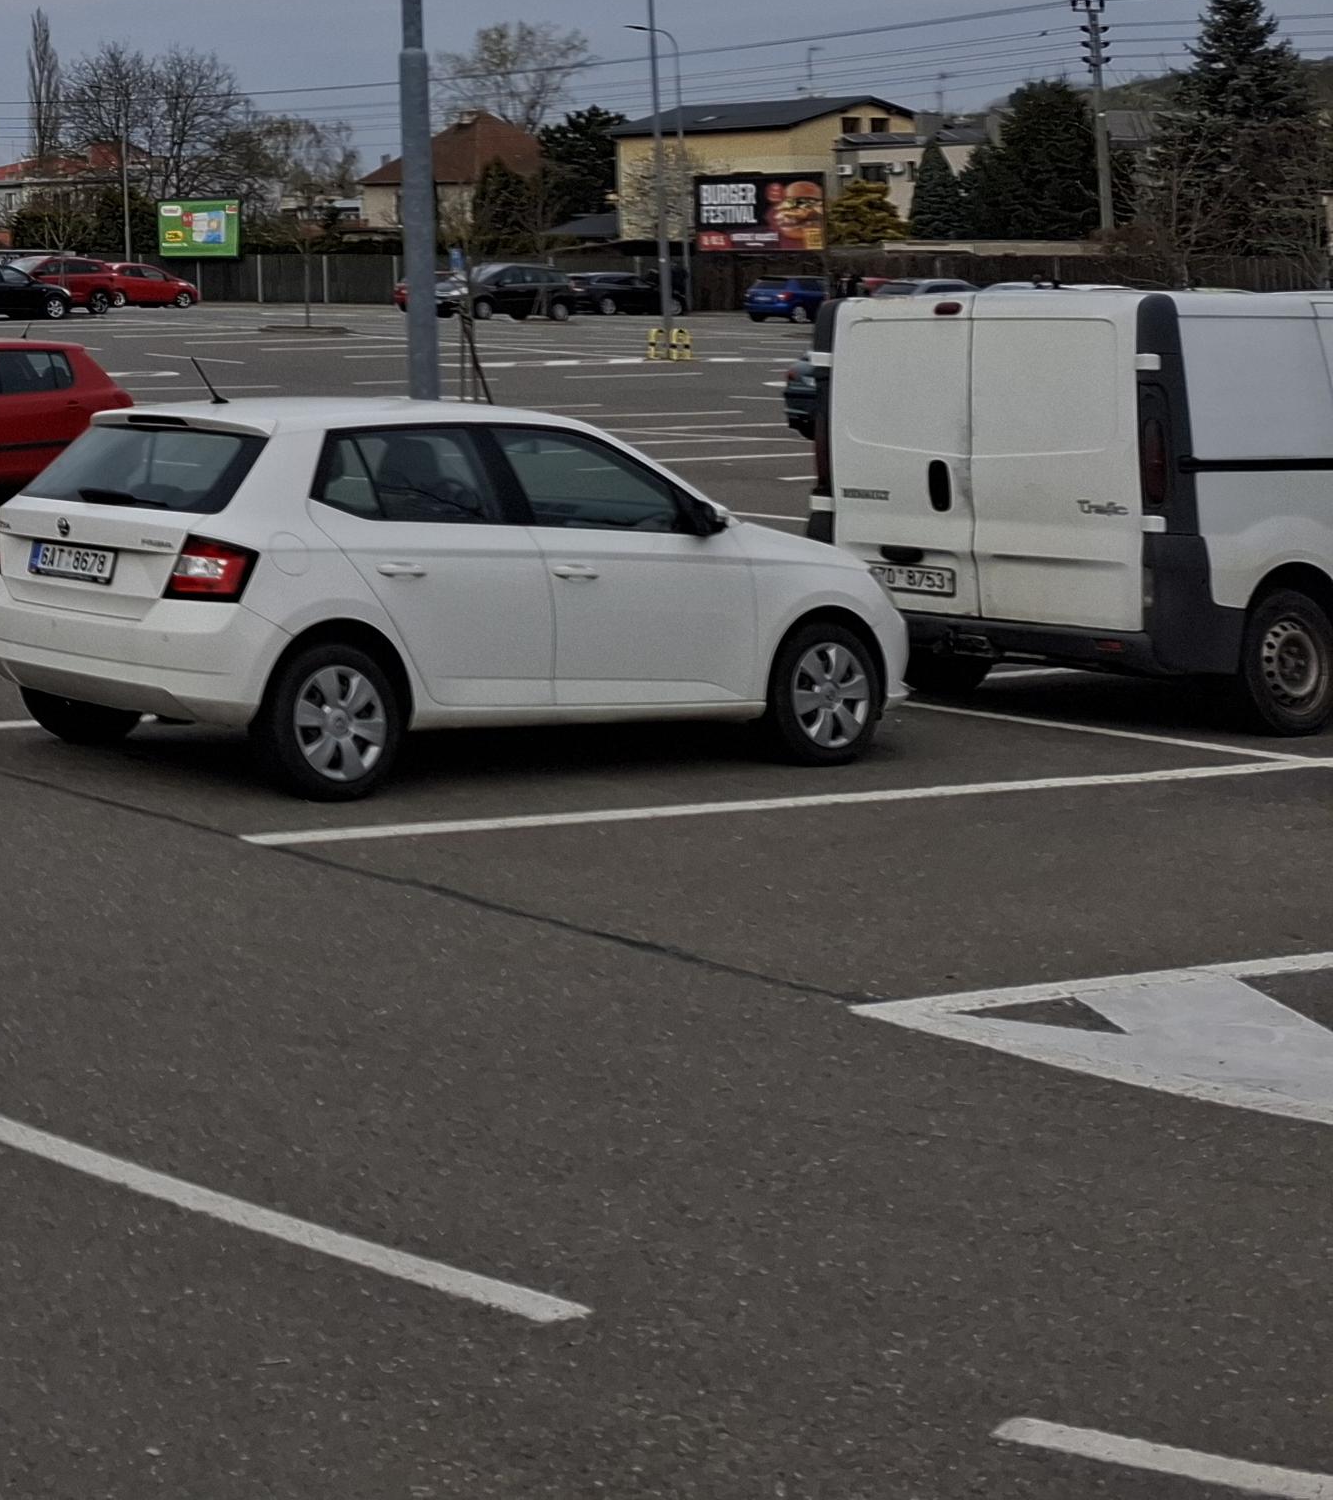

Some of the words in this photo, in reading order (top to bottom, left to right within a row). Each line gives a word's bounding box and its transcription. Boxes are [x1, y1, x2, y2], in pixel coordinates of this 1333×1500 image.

[699, 183, 757, 205] BURGER
[700, 205, 758, 224] FESTIVAL
[40, 546, 65, 569] 6AT
[72, 550, 107, 574] 8678
[907, 569, 946, 590] 8753
